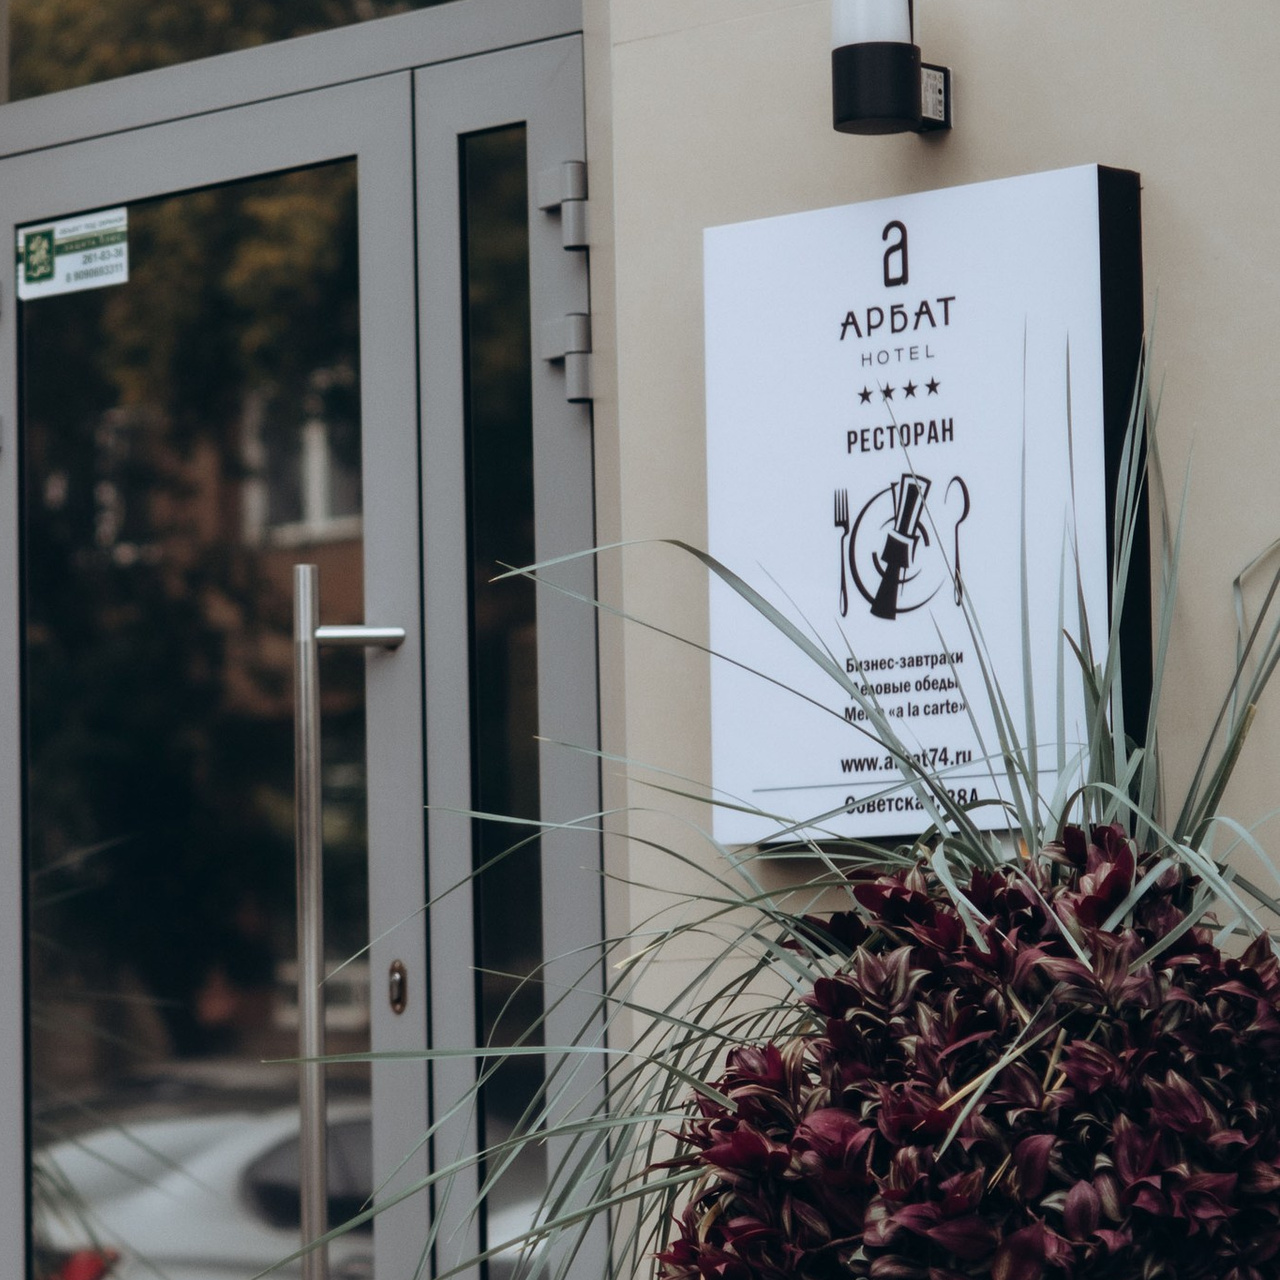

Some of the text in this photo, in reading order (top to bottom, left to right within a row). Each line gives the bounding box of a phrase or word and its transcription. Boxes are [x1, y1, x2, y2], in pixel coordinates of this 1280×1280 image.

[839, 296, 957, 342] АРБАТ
[860, 344, 936, 368] HOTEL
[846, 417, 955, 455] РЕСТОРАН
[846, 651, 964, 673] Бизнес-завтраки
[915, 674, 959, 692] обеды
[908, 702, 920, 717] la
[923, 699, 967, 716] carte»
[840, 747, 973, 773] www.aat74.ru
